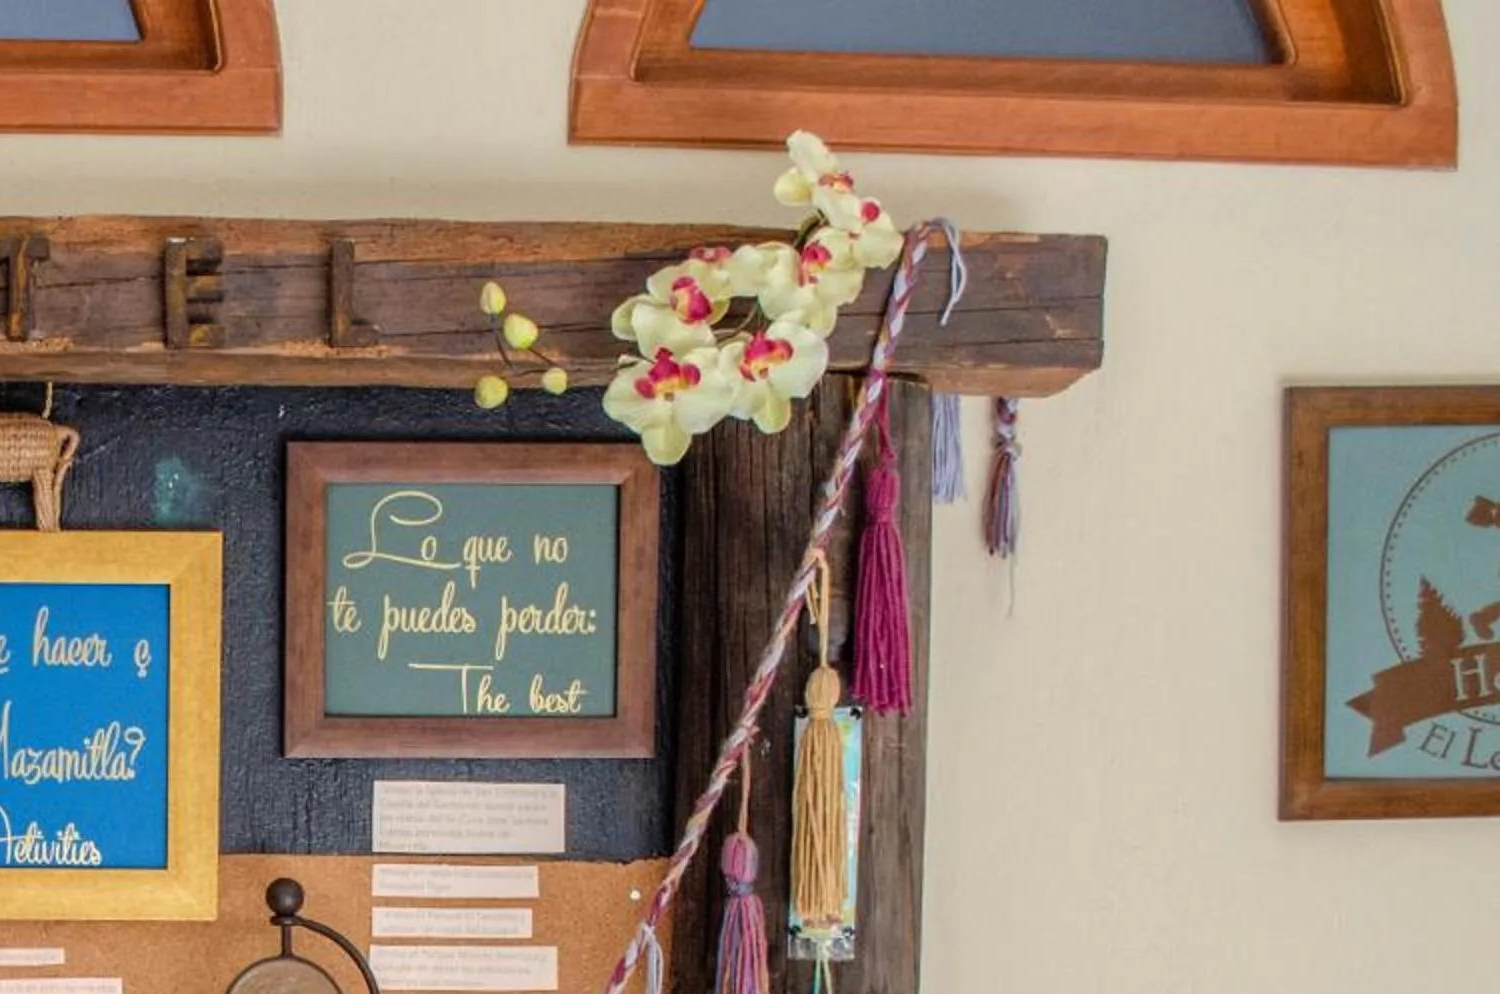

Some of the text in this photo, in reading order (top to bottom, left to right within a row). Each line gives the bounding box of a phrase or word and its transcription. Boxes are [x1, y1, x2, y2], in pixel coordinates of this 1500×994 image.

[343, 491, 568, 588] Lo que no
[32, 606, 112, 666] hacer
[328, 580, 596, 661] te puedes perder:
[408, 663, 588, 714] The best
[1417, 722, 1456, 760] El
